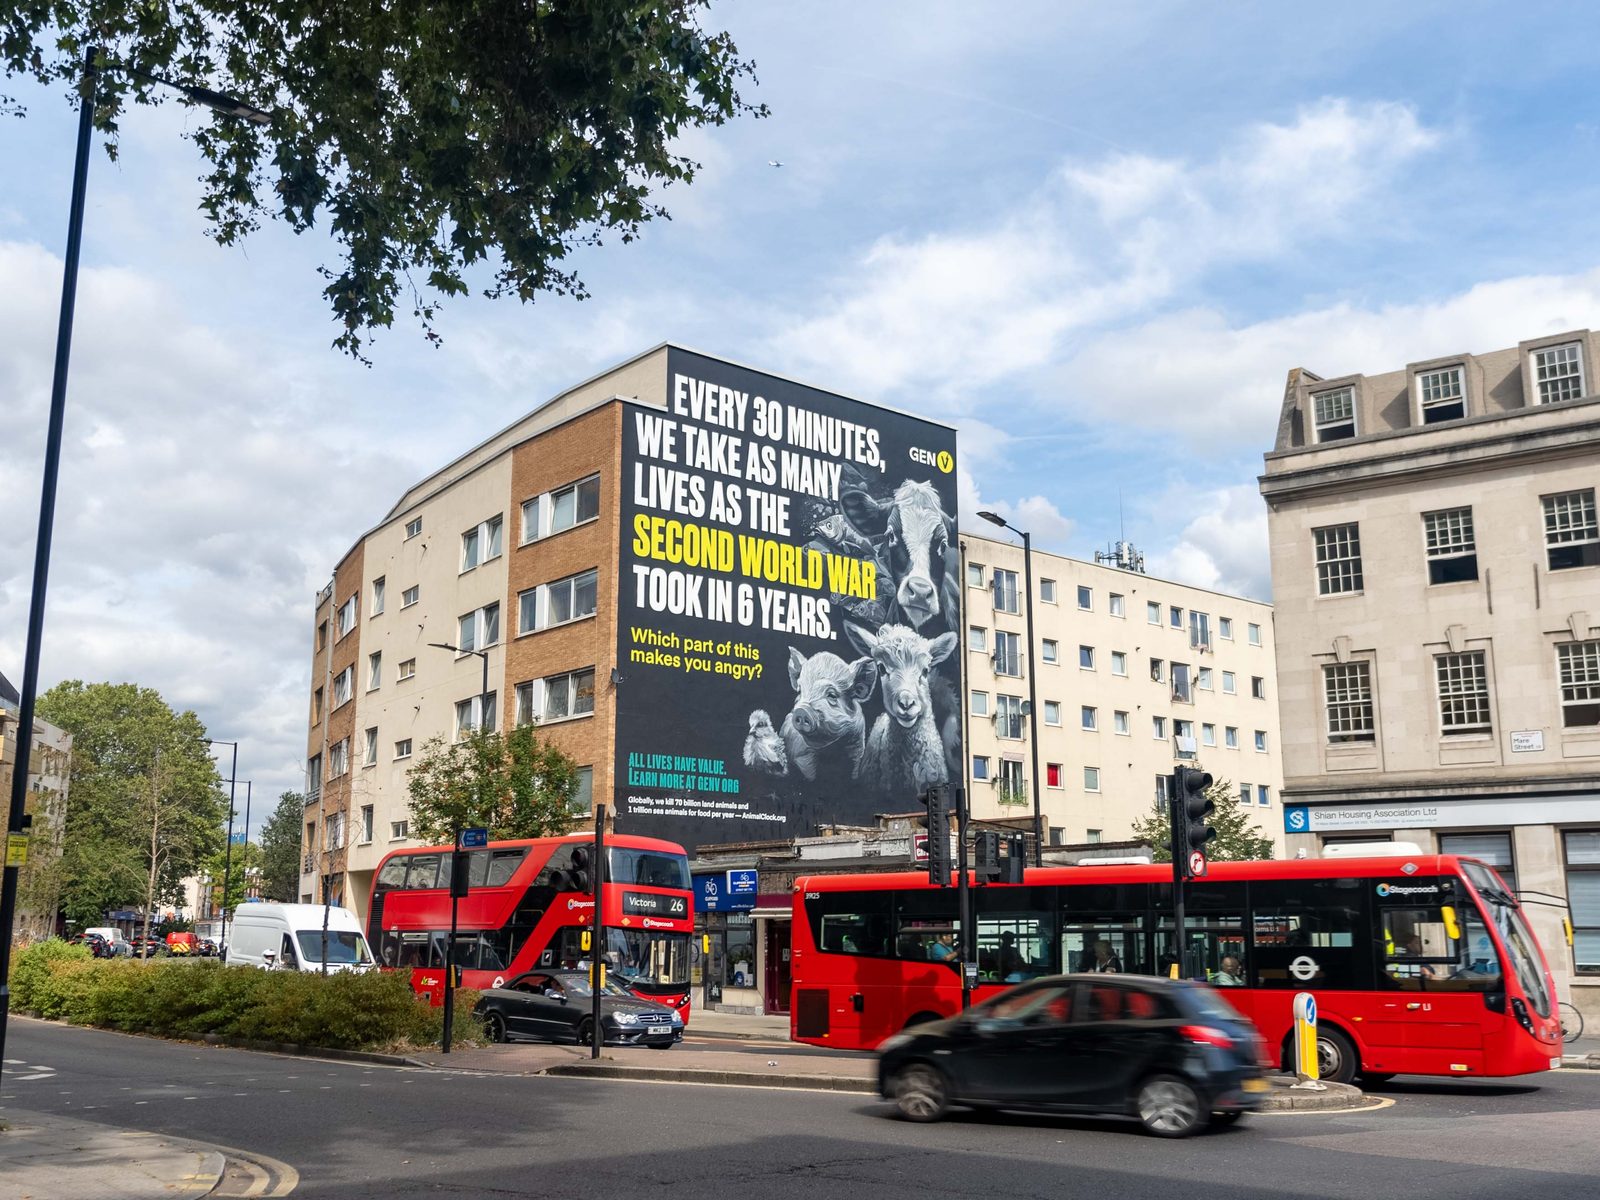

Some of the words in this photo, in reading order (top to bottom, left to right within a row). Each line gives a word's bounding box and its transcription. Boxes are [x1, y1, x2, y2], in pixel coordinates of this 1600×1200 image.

[674, 373, 749, 432] EVERY
[752, 396, 783, 441] 30
[787, 405, 886, 474] MINUTES,
[635, 412, 677, 463] WE
[681, 423, 742, 478] TAKE
[745, 441, 777, 486] AS
[781, 449, 842, 502] MANY
[909, 446, 936, 467] GEN
[634, 461, 706, 518] LIVES
[709, 480, 743, 526] AS
[746, 487, 791, 537] THE
[632, 513, 735, 572] SECOND
[738, 534, 823, 591] WORLD
[826, 552, 877, 601] WAR
[632, 564, 704, 619] TOOK
[707, 577, 733, 624] IN
[737, 583, 754, 627] 6
[757, 586, 838, 641] YEARS.
[630, 626, 680, 649] Which
[683, 637, 714, 654] part
[716, 640, 732, 656] of
[733, 642, 760, 661] this
[630, 649, 681, 668] makes
[683, 656, 711, 673] you
[714, 660, 763, 681] angry?
[628, 752, 646, 768] ALL
[646, 753, 673, 771] LIVES
[674, 756, 697, 773] HAVE
[698, 758, 727, 776] VALUE.
[659, 772, 685, 790] MORE
[685, 774, 697, 790] AT
[627, 796, 655, 806] Globally,
[665, 798, 674, 806] kill
[683, 799, 702, 807] billion
[701, 800, 715, 808] land
[715, 801, 737, 809] animals
[1314, 811, 1337, 820] Shian
[1338, 809, 1372, 820] Housing
[1373, 808, 1421, 818] Association
[1422, 807, 1438, 817] Ltd
[633, 806, 652, 814] trillion
[665, 808, 688, 816] animals
[698, 809, 711, 817] food
[722, 812, 735, 820] year
[742, 812, 787, 823] AnimalClock.org
[1389, 885, 1439, 895] Stagecoach
[628, 896, 657, 909] Victoria
[669, 897, 684, 912] 26
[650, 920, 674, 928] Stagecoach
